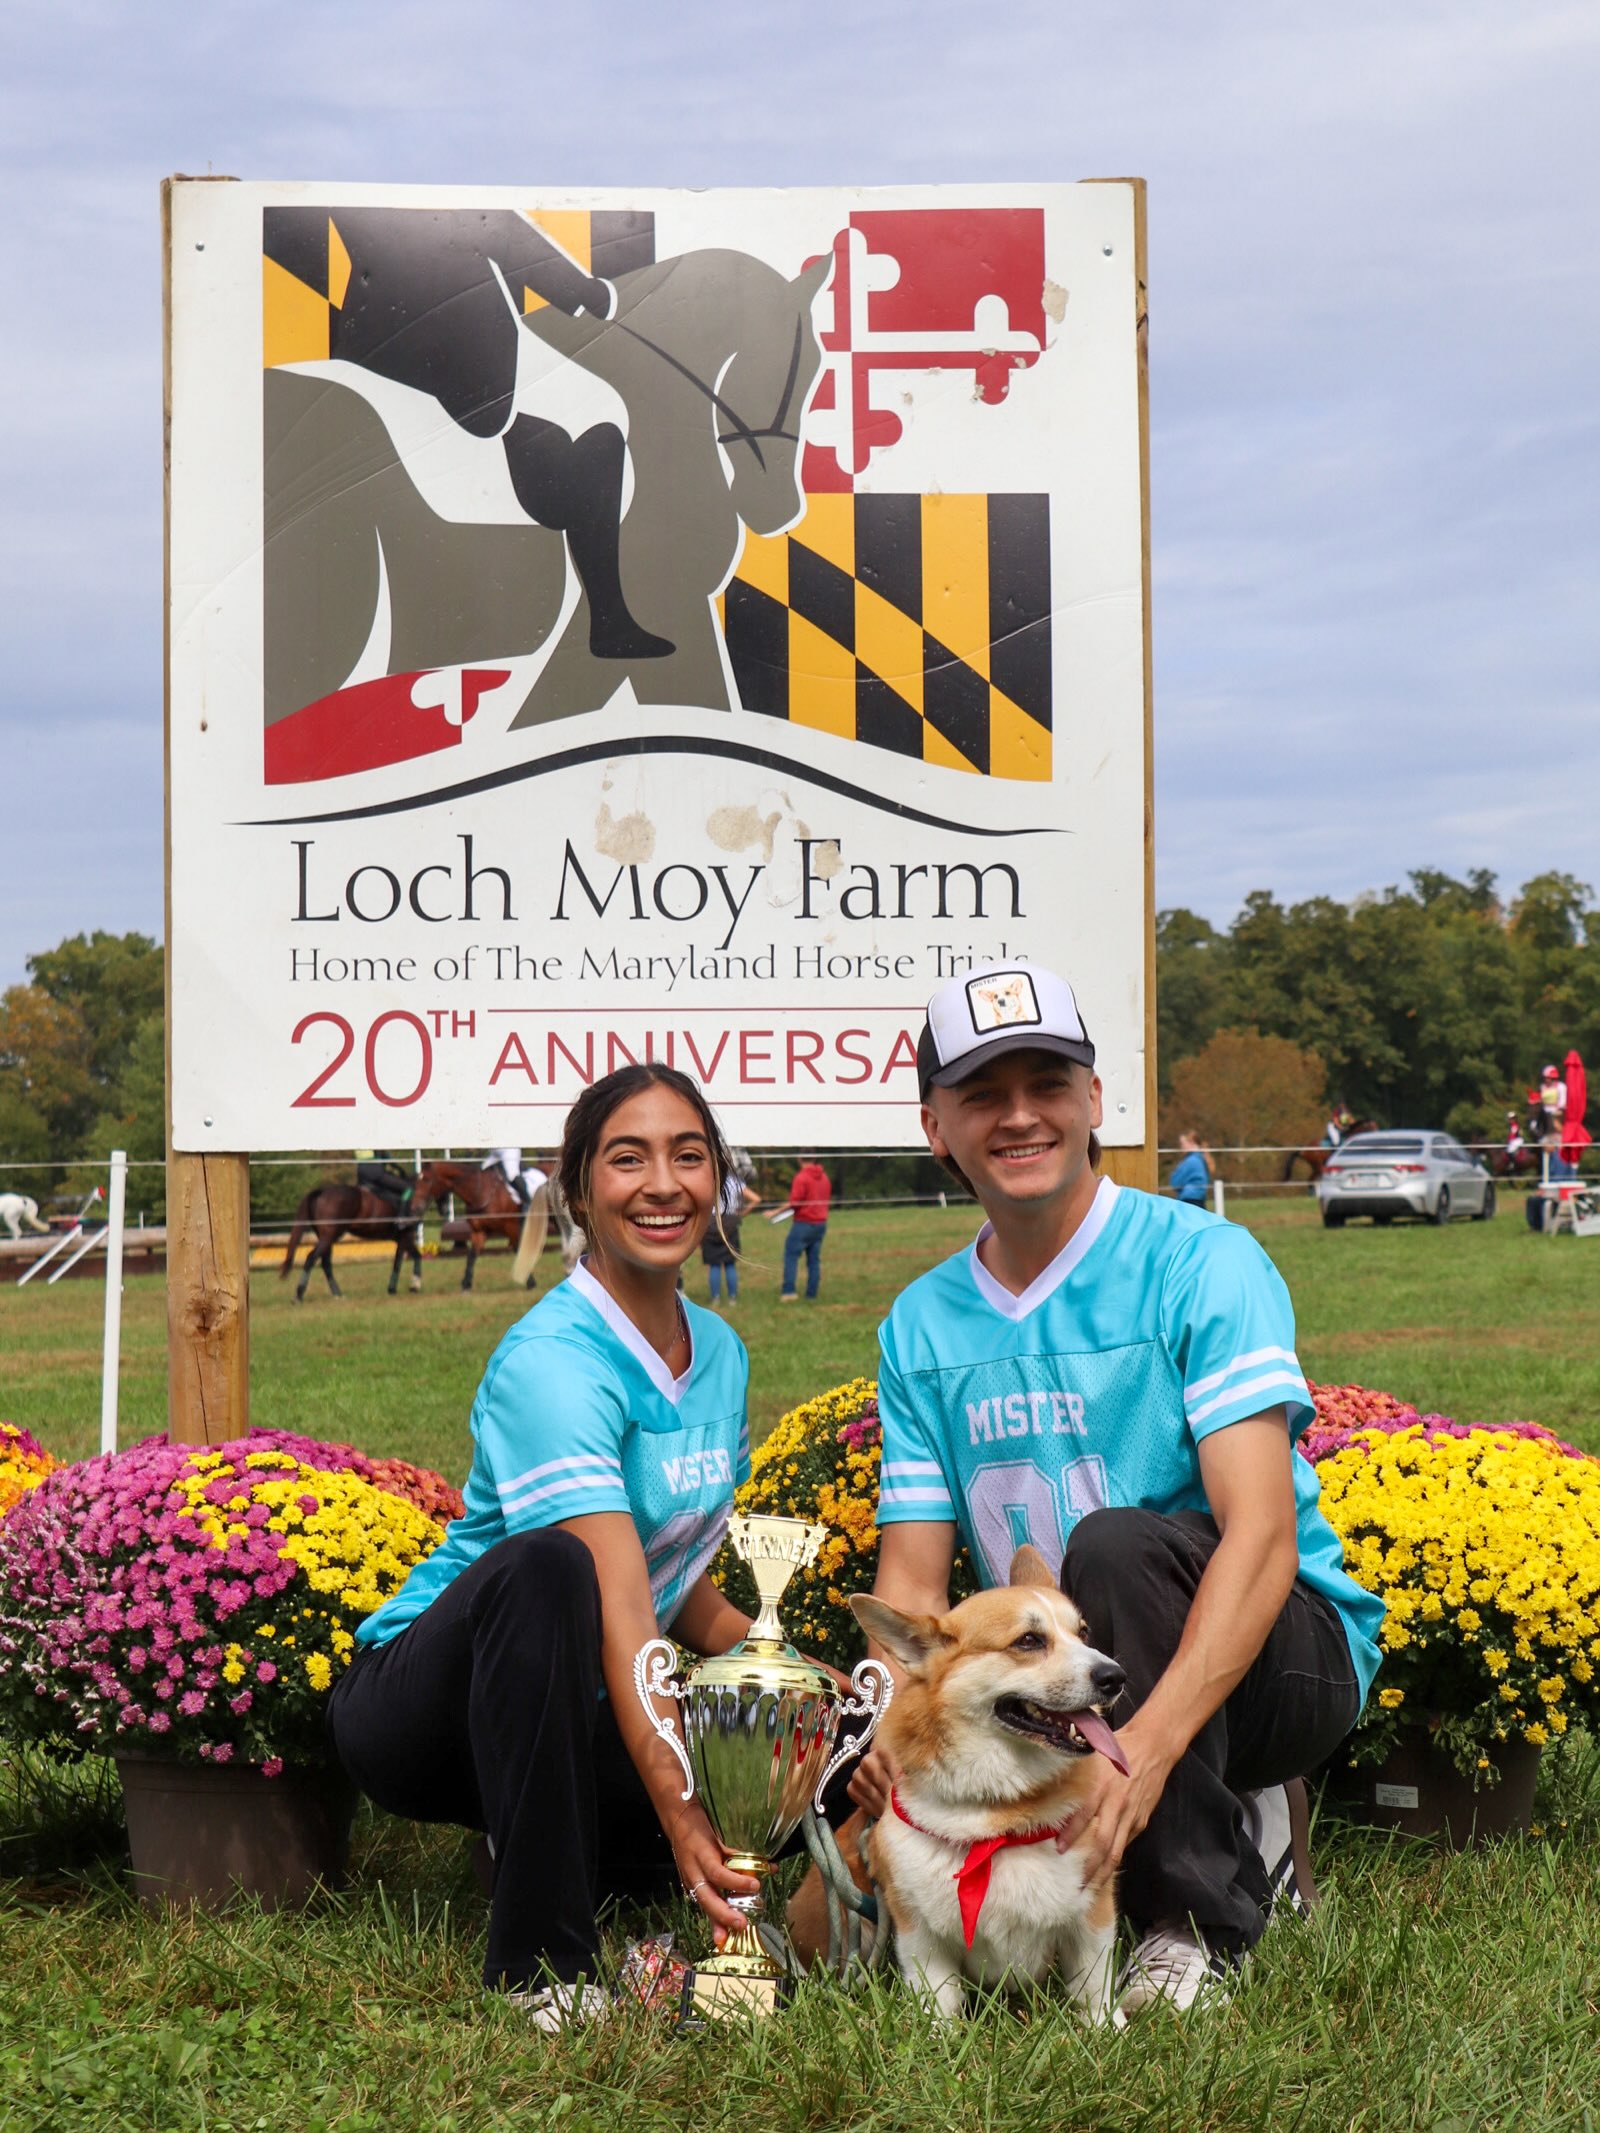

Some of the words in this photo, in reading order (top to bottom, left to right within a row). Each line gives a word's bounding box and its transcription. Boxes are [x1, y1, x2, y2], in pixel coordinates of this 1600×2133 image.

[290, 834, 519, 922] Loch
[550, 838, 766, 950] Moy
[794, 838, 1027, 920] Farm
[289, 947, 417, 982] Home
[433, 945, 480, 982] of
[486, 946, 563, 982] The
[578, 943, 779, 992] Maryland
[794, 945, 916, 980] Horse
[926, 942, 1029, 978] Tri
[289, 1009, 476, 1108] 20TH
[488, 1029, 927, 1086] ANNIVERSA
[965, 1391, 1088, 1446] MISTER
[731, 1533, 820, 1569] WINNER
